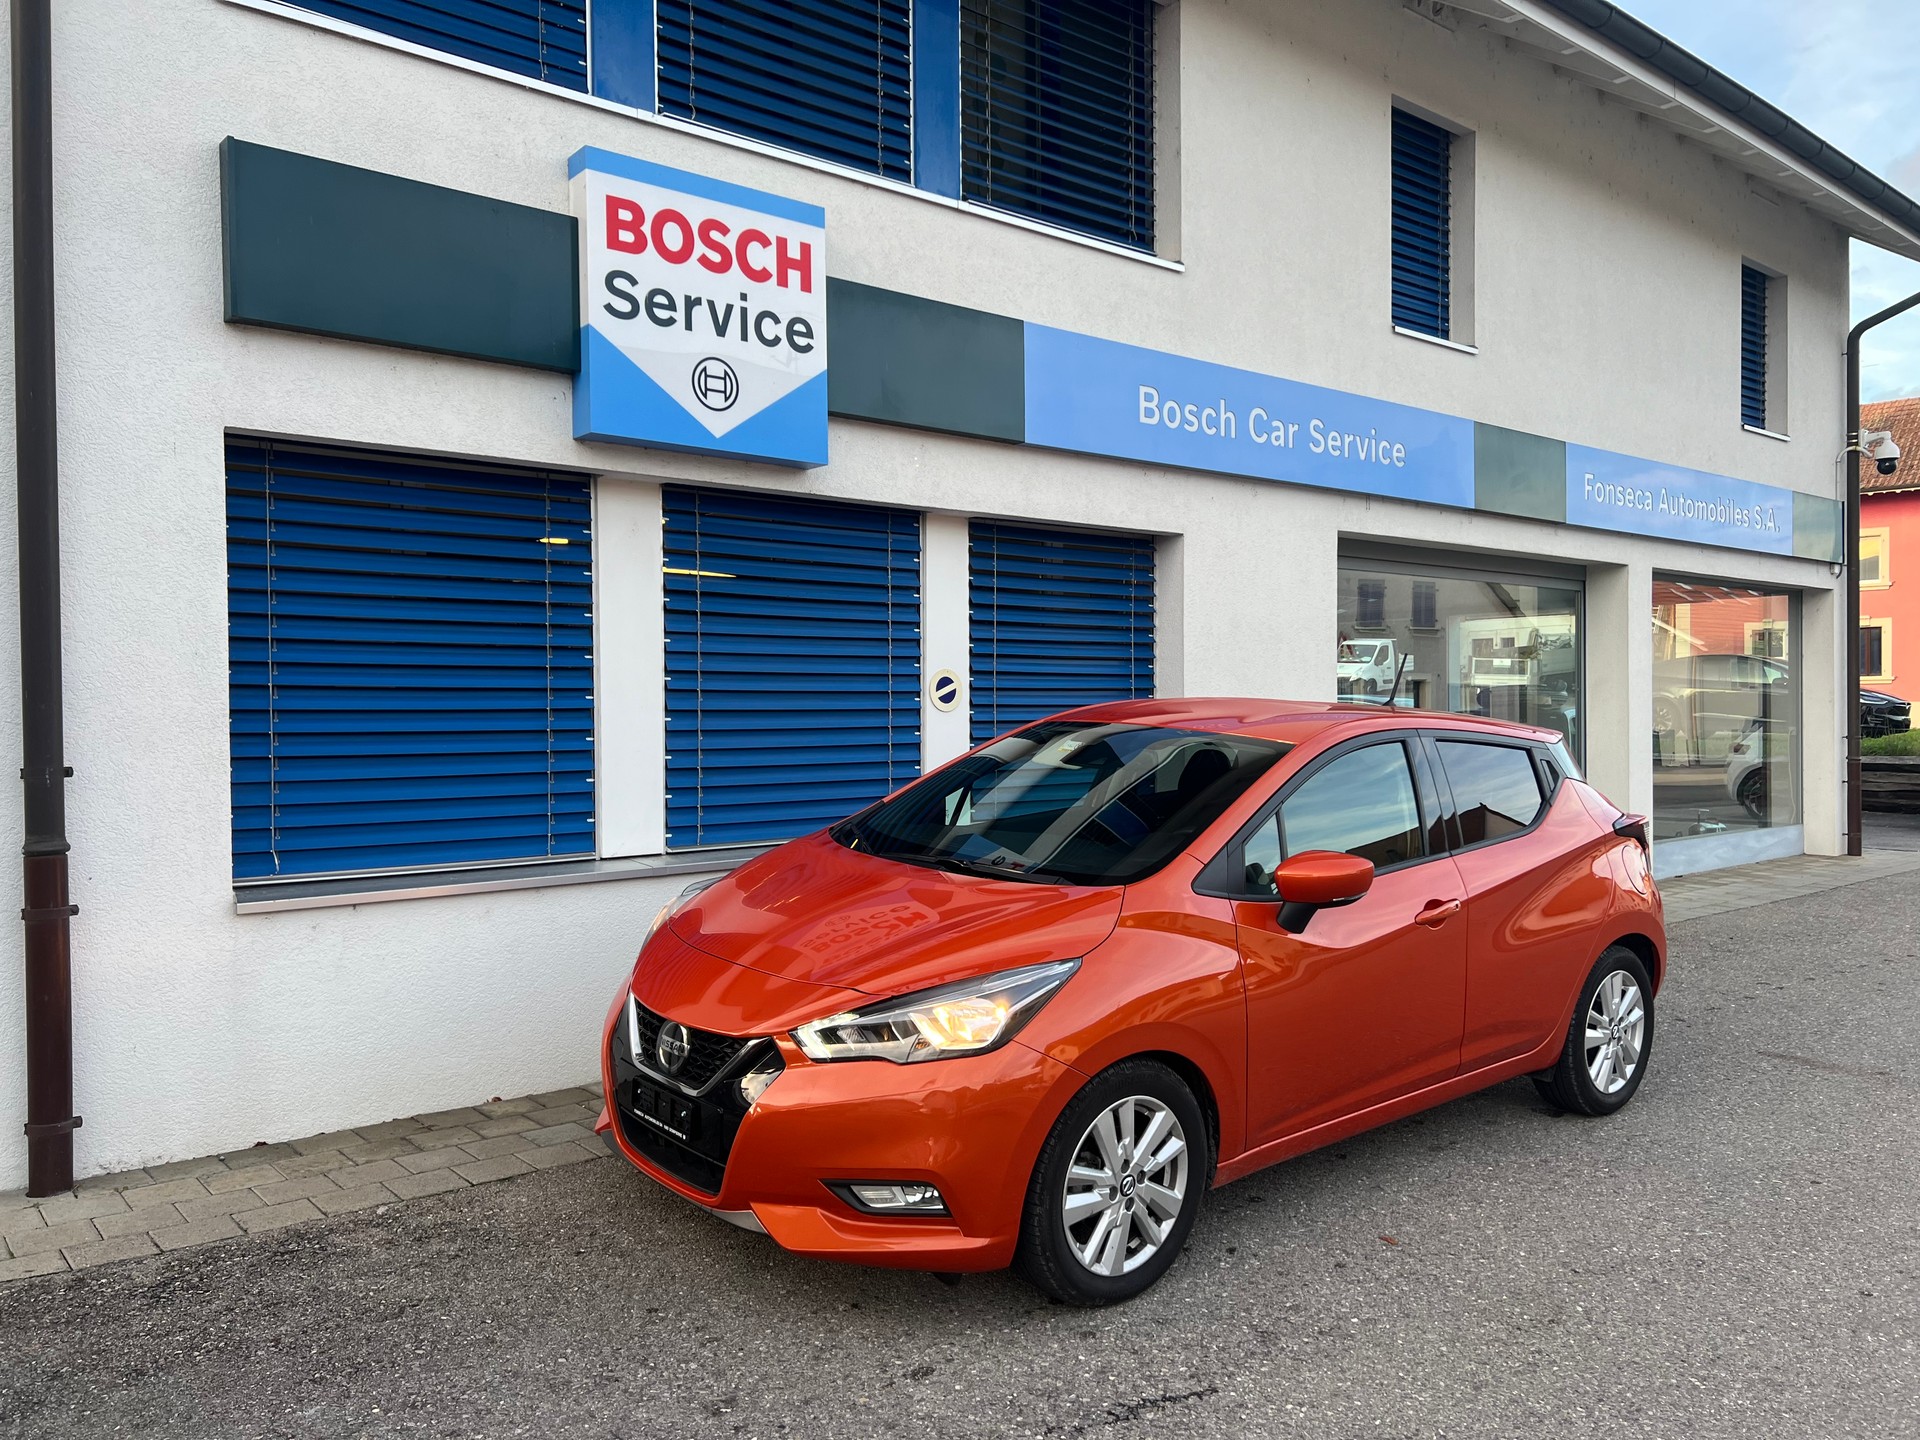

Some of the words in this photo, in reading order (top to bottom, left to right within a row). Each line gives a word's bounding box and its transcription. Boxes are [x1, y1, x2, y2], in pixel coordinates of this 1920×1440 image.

[605, 194, 812, 294] BOSCH
[602, 269, 815, 354] Service
[1138, 384, 1237, 439] Bosch
[1248, 406, 1300, 449] Car
[1308, 418, 1407, 468] Service
[1584, 472, 1654, 512] Fonseca
[1658, 487, 1751, 528] Automobiles
[1754, 504, 1781, 533] S.A.
